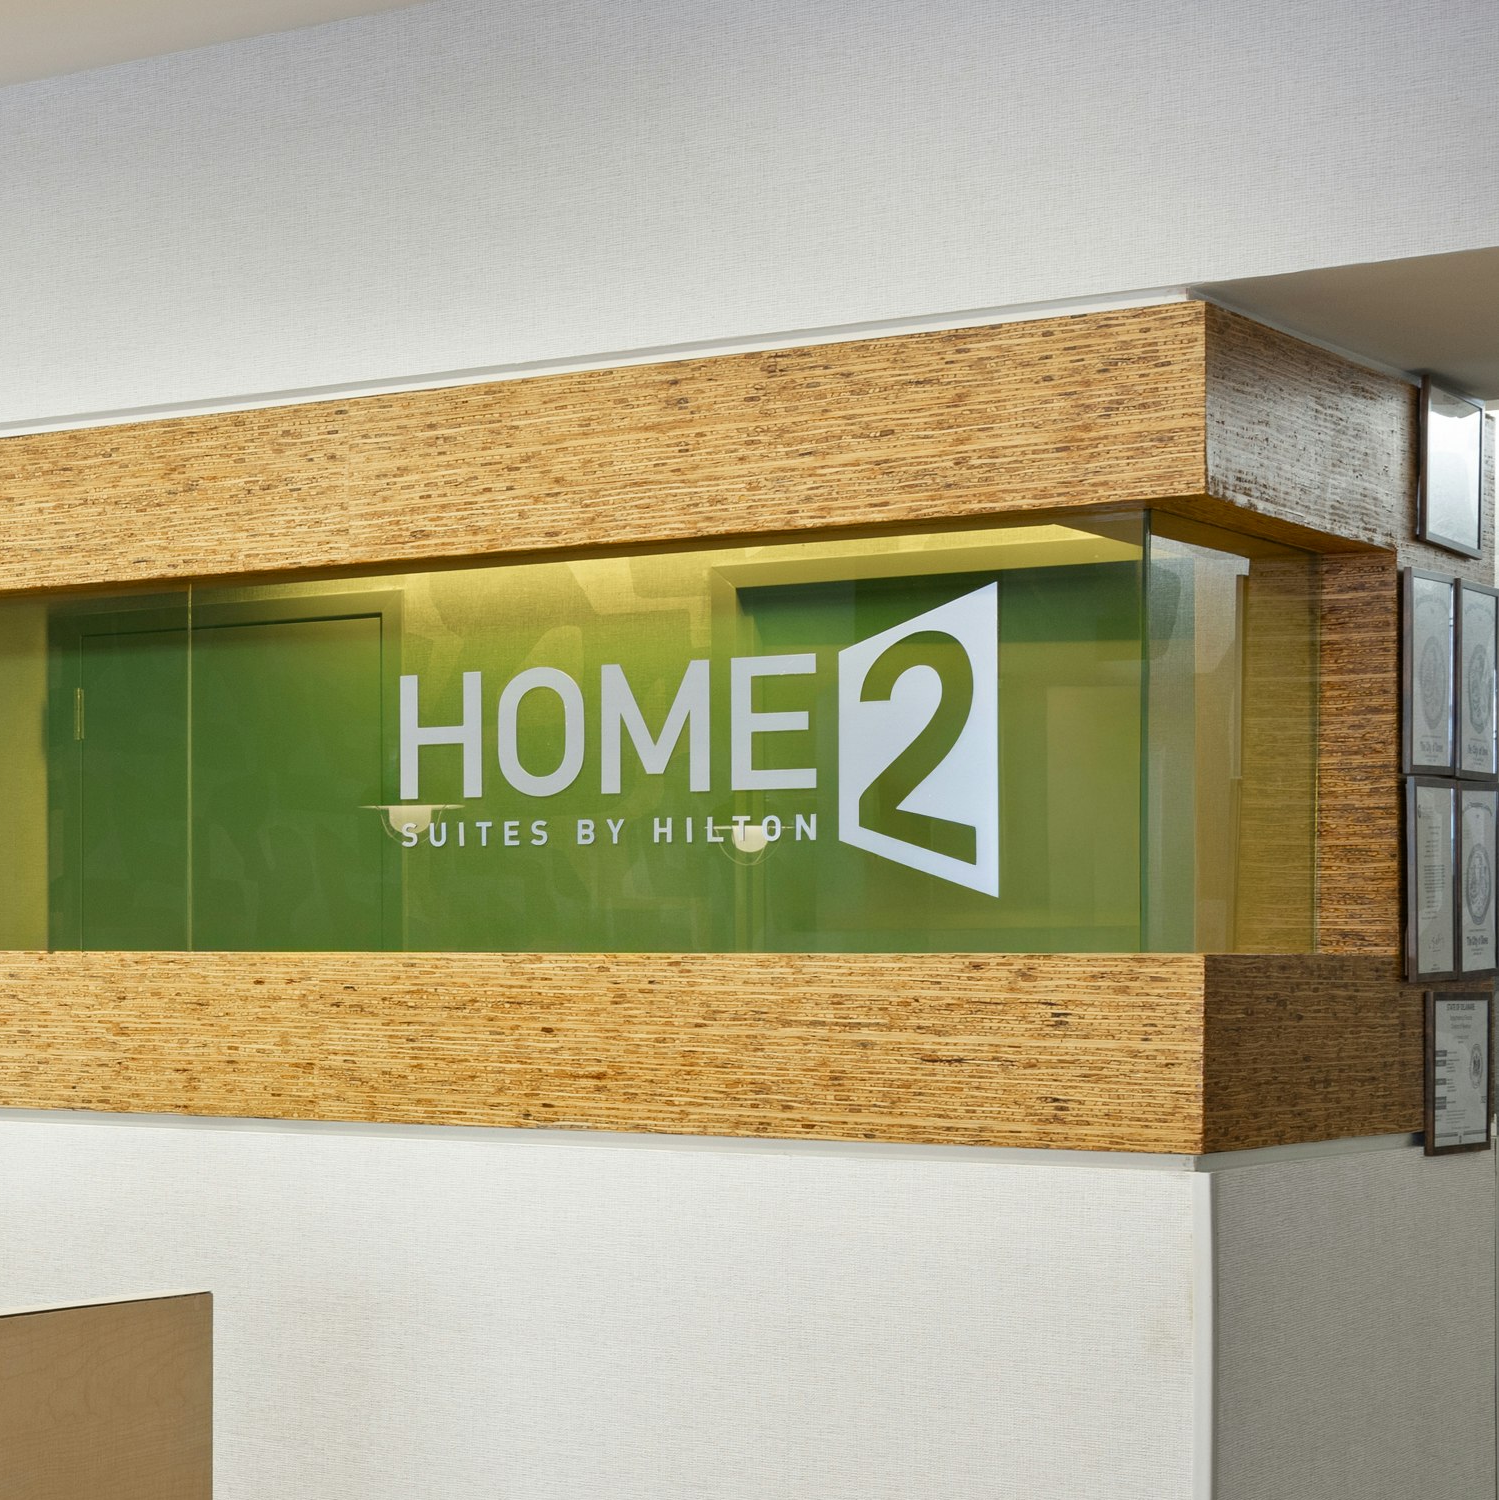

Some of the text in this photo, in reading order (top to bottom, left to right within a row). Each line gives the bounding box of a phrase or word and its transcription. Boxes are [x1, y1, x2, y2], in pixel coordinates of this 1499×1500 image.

[399, 653, 818, 800] HOME
[401, 812, 818, 848] SUITES BY HILTON
